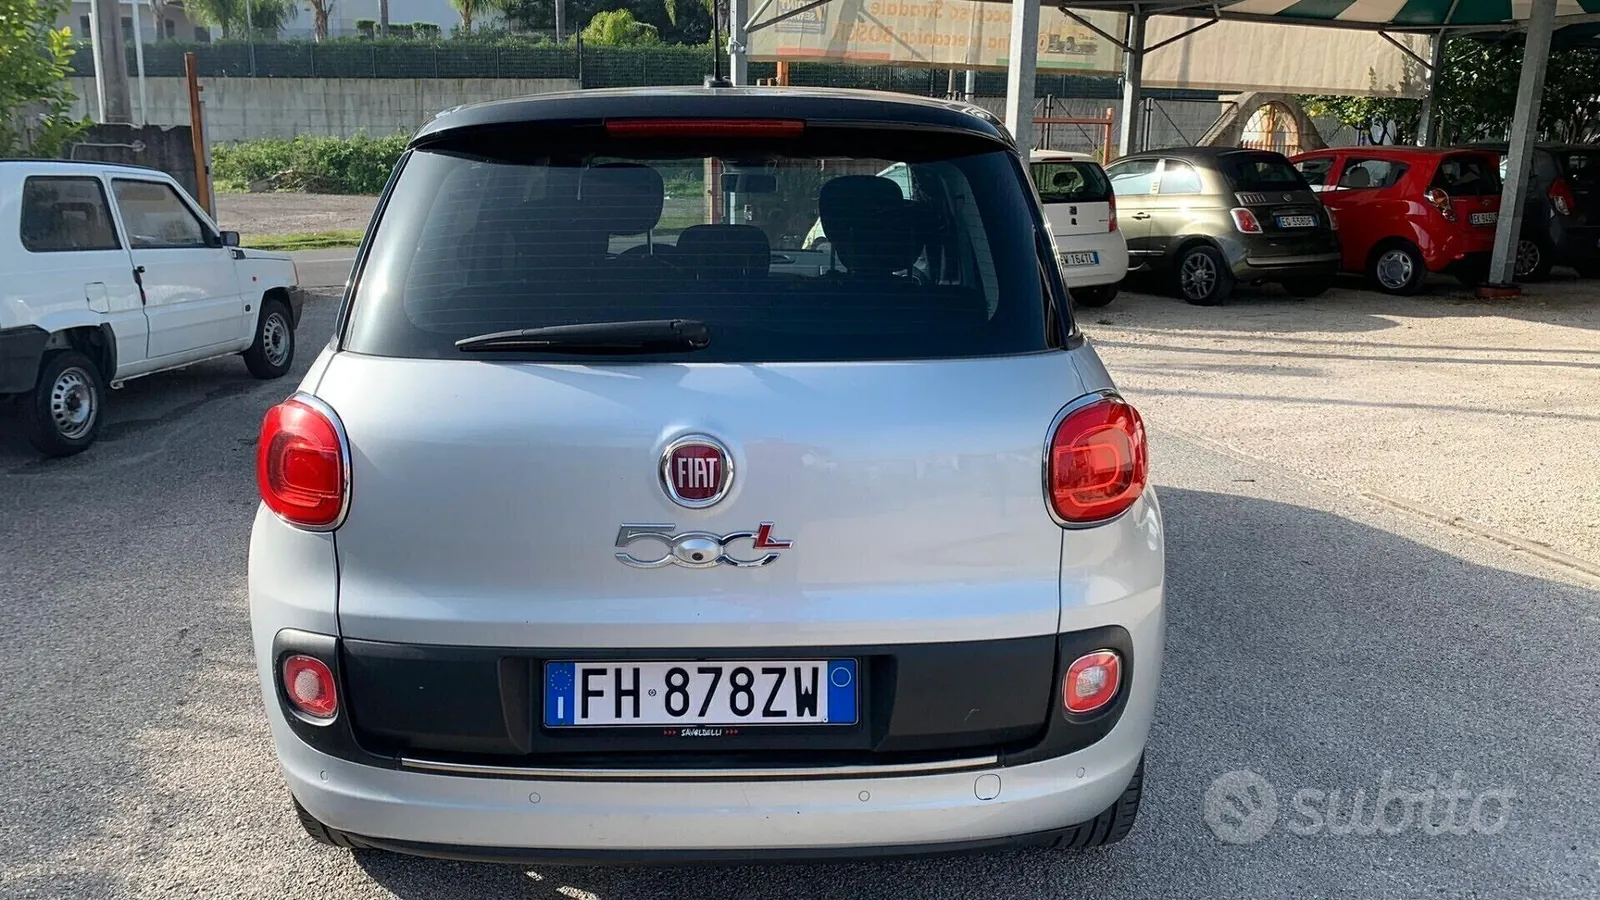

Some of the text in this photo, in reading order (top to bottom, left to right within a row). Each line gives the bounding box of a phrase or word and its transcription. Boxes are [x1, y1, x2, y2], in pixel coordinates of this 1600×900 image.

[1071, 253, 1095, 265] 164TL
[677, 457, 718, 488] FIAT
[615, 521, 794, 569] 500L
[581, 667, 641, 719] FH
[664, 666, 820, 718] 878ZW
